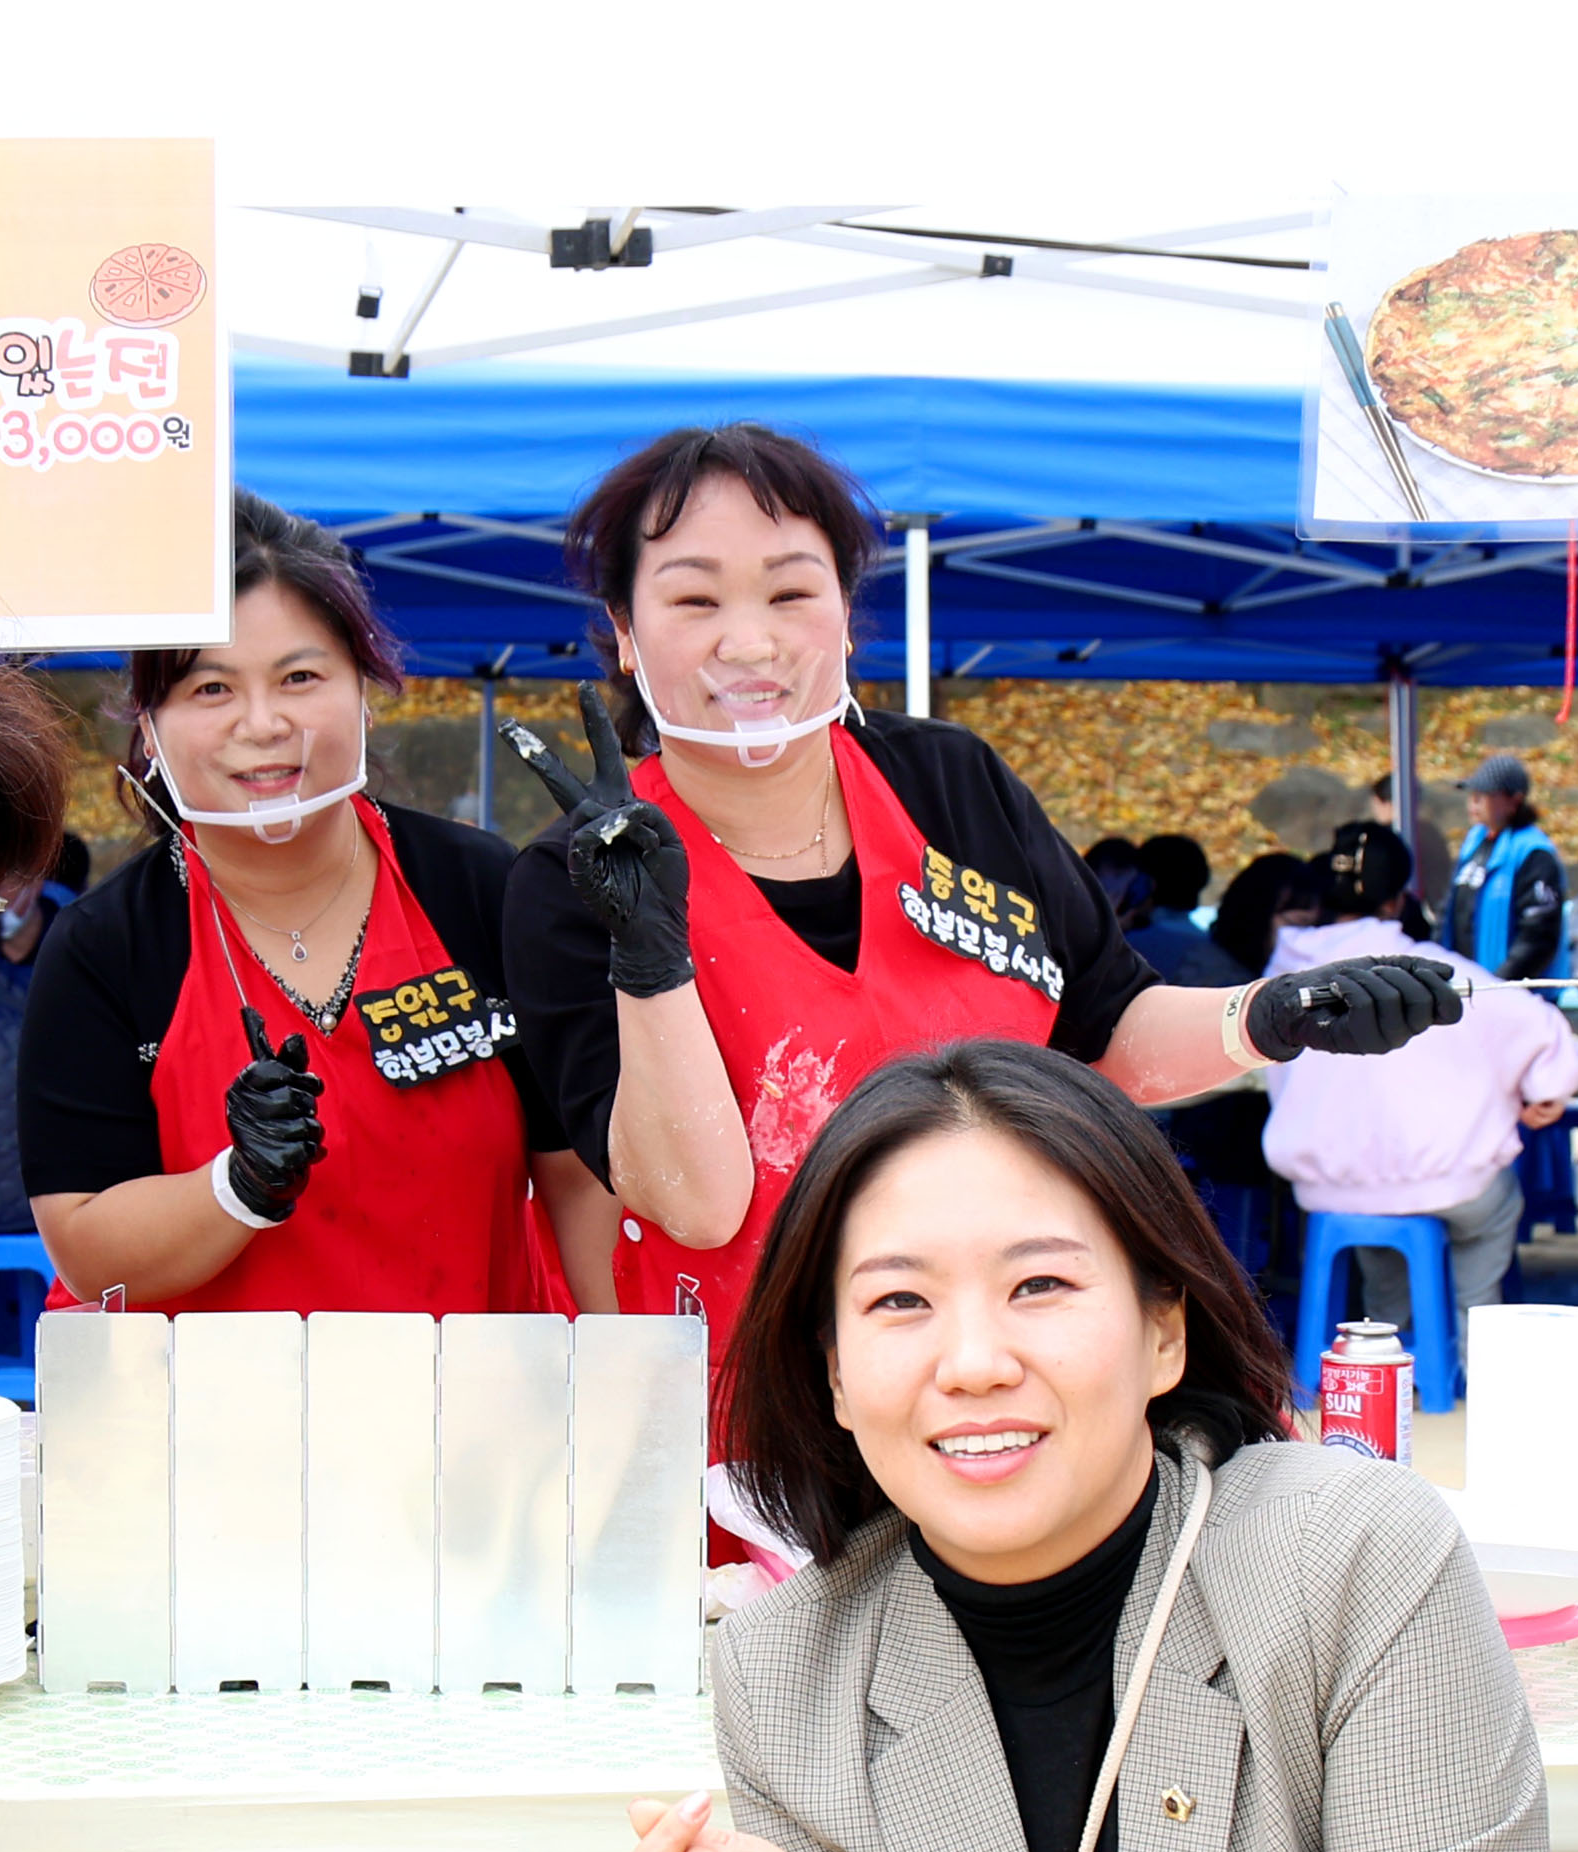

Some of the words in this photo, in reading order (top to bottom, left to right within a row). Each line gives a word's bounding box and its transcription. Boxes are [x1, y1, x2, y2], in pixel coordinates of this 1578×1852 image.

[2, 410, 190, 465] 3,000원
[901, 884, 1064, 1001] 학부모봉사단
[1325, 1392, 1362, 1413] SUN
